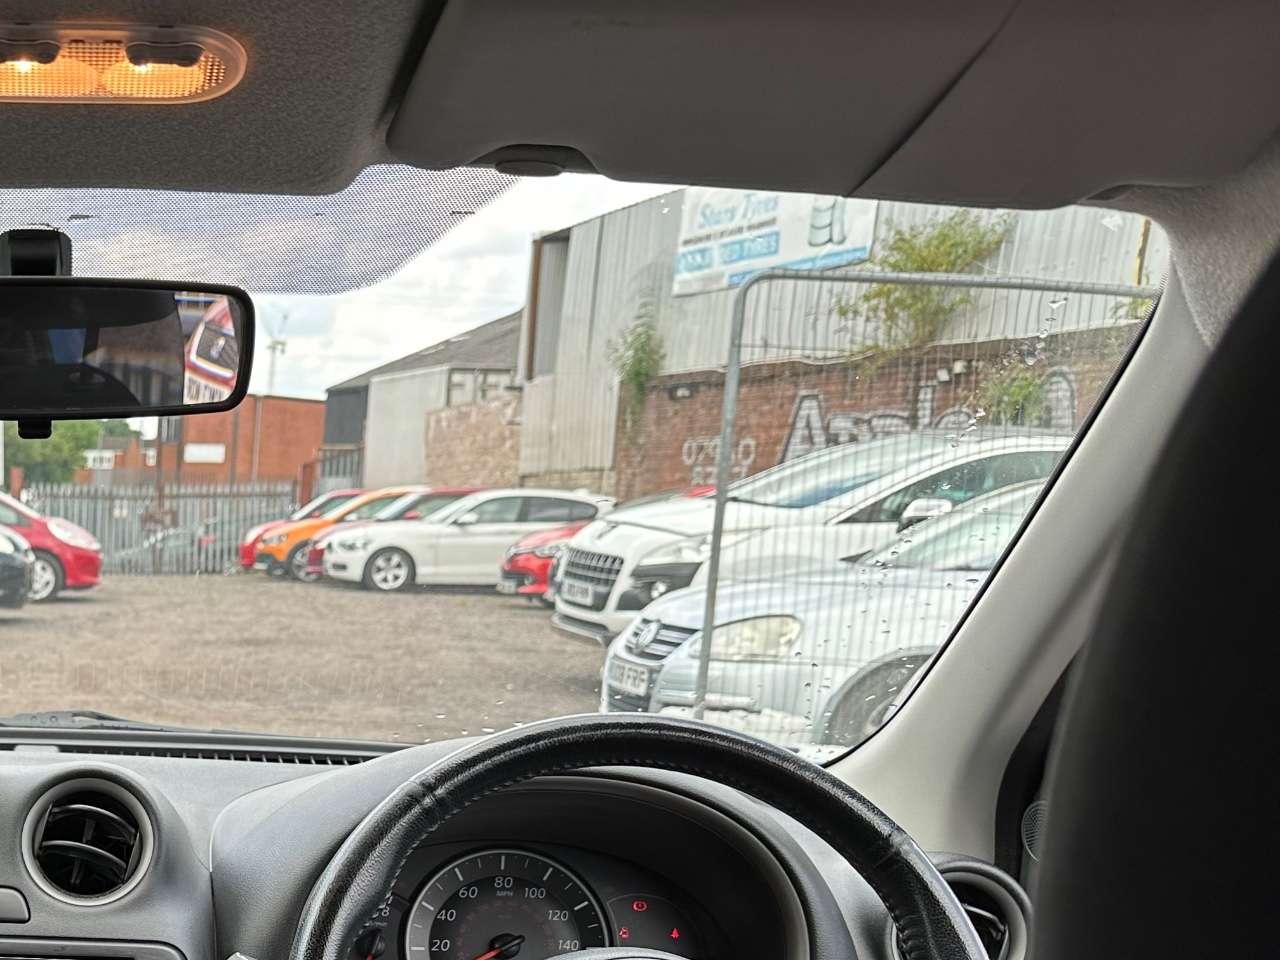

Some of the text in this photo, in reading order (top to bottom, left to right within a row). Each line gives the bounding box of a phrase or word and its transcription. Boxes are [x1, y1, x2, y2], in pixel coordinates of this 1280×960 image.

[494, 876, 513, 888] 80
[458, 886, 478, 898] 60
[524, 887, 546, 899] 100
[437, 909, 456, 921] 40
[548, 910, 569, 921] 120
[431, 939, 450, 951] 20
[558, 939, 579, 951] 140
